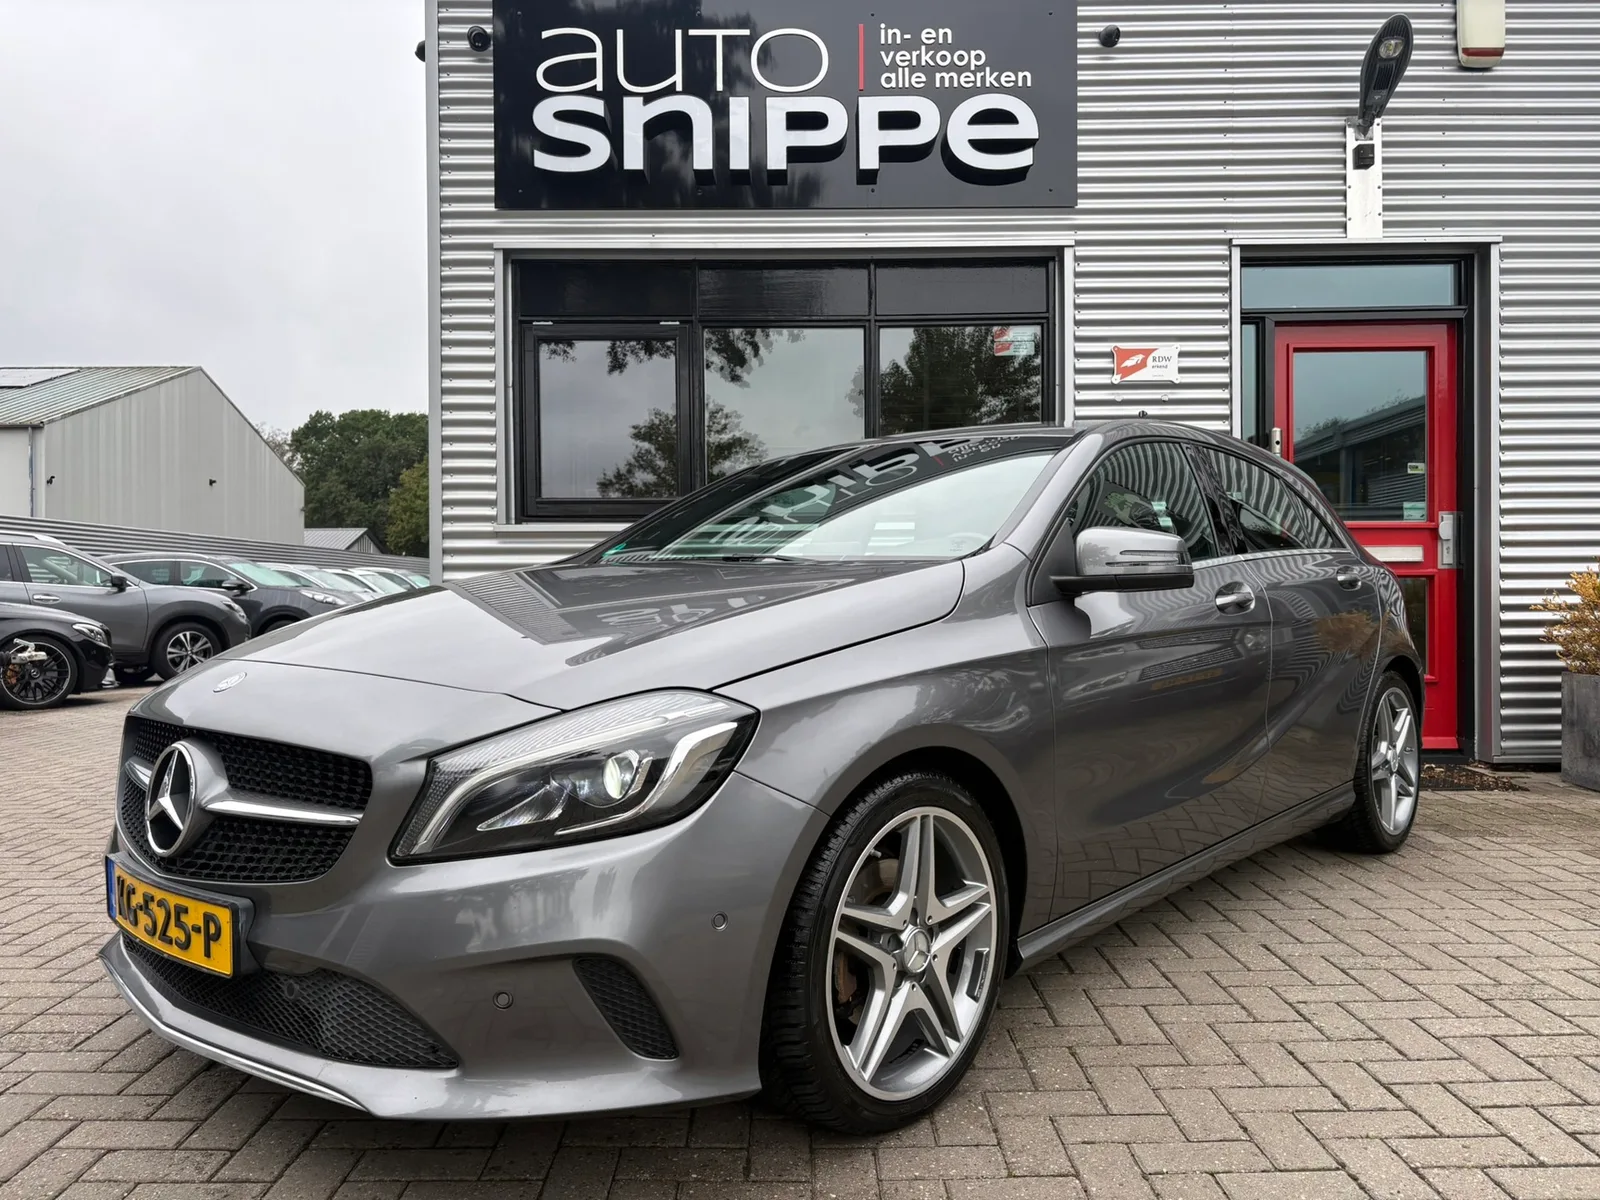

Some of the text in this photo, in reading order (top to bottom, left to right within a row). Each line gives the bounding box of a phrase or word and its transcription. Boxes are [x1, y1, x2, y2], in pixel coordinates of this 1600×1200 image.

[880, 22, 953, 45] in- en
[879, 45, 986, 71] verkoop
[880, 66, 1032, 88] alle merken
[1152, 355, 1172, 363] RDW
